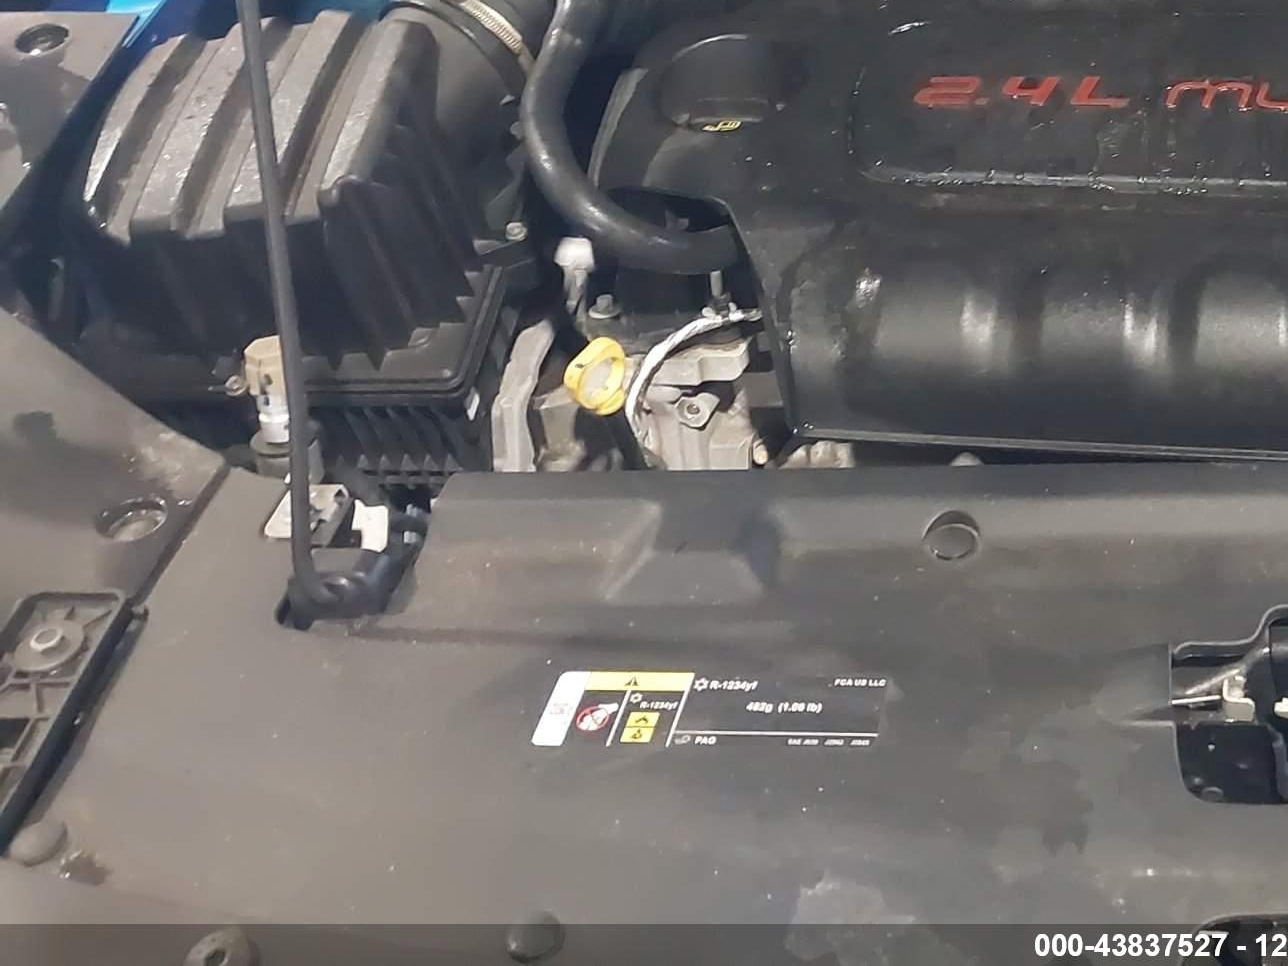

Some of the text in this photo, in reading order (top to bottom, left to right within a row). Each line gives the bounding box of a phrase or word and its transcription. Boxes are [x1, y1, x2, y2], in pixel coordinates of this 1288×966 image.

[709, 680, 759, 692] R-1234yf
[834, 678, 853, 687] FCA
[868, 679, 887, 687] LLC
